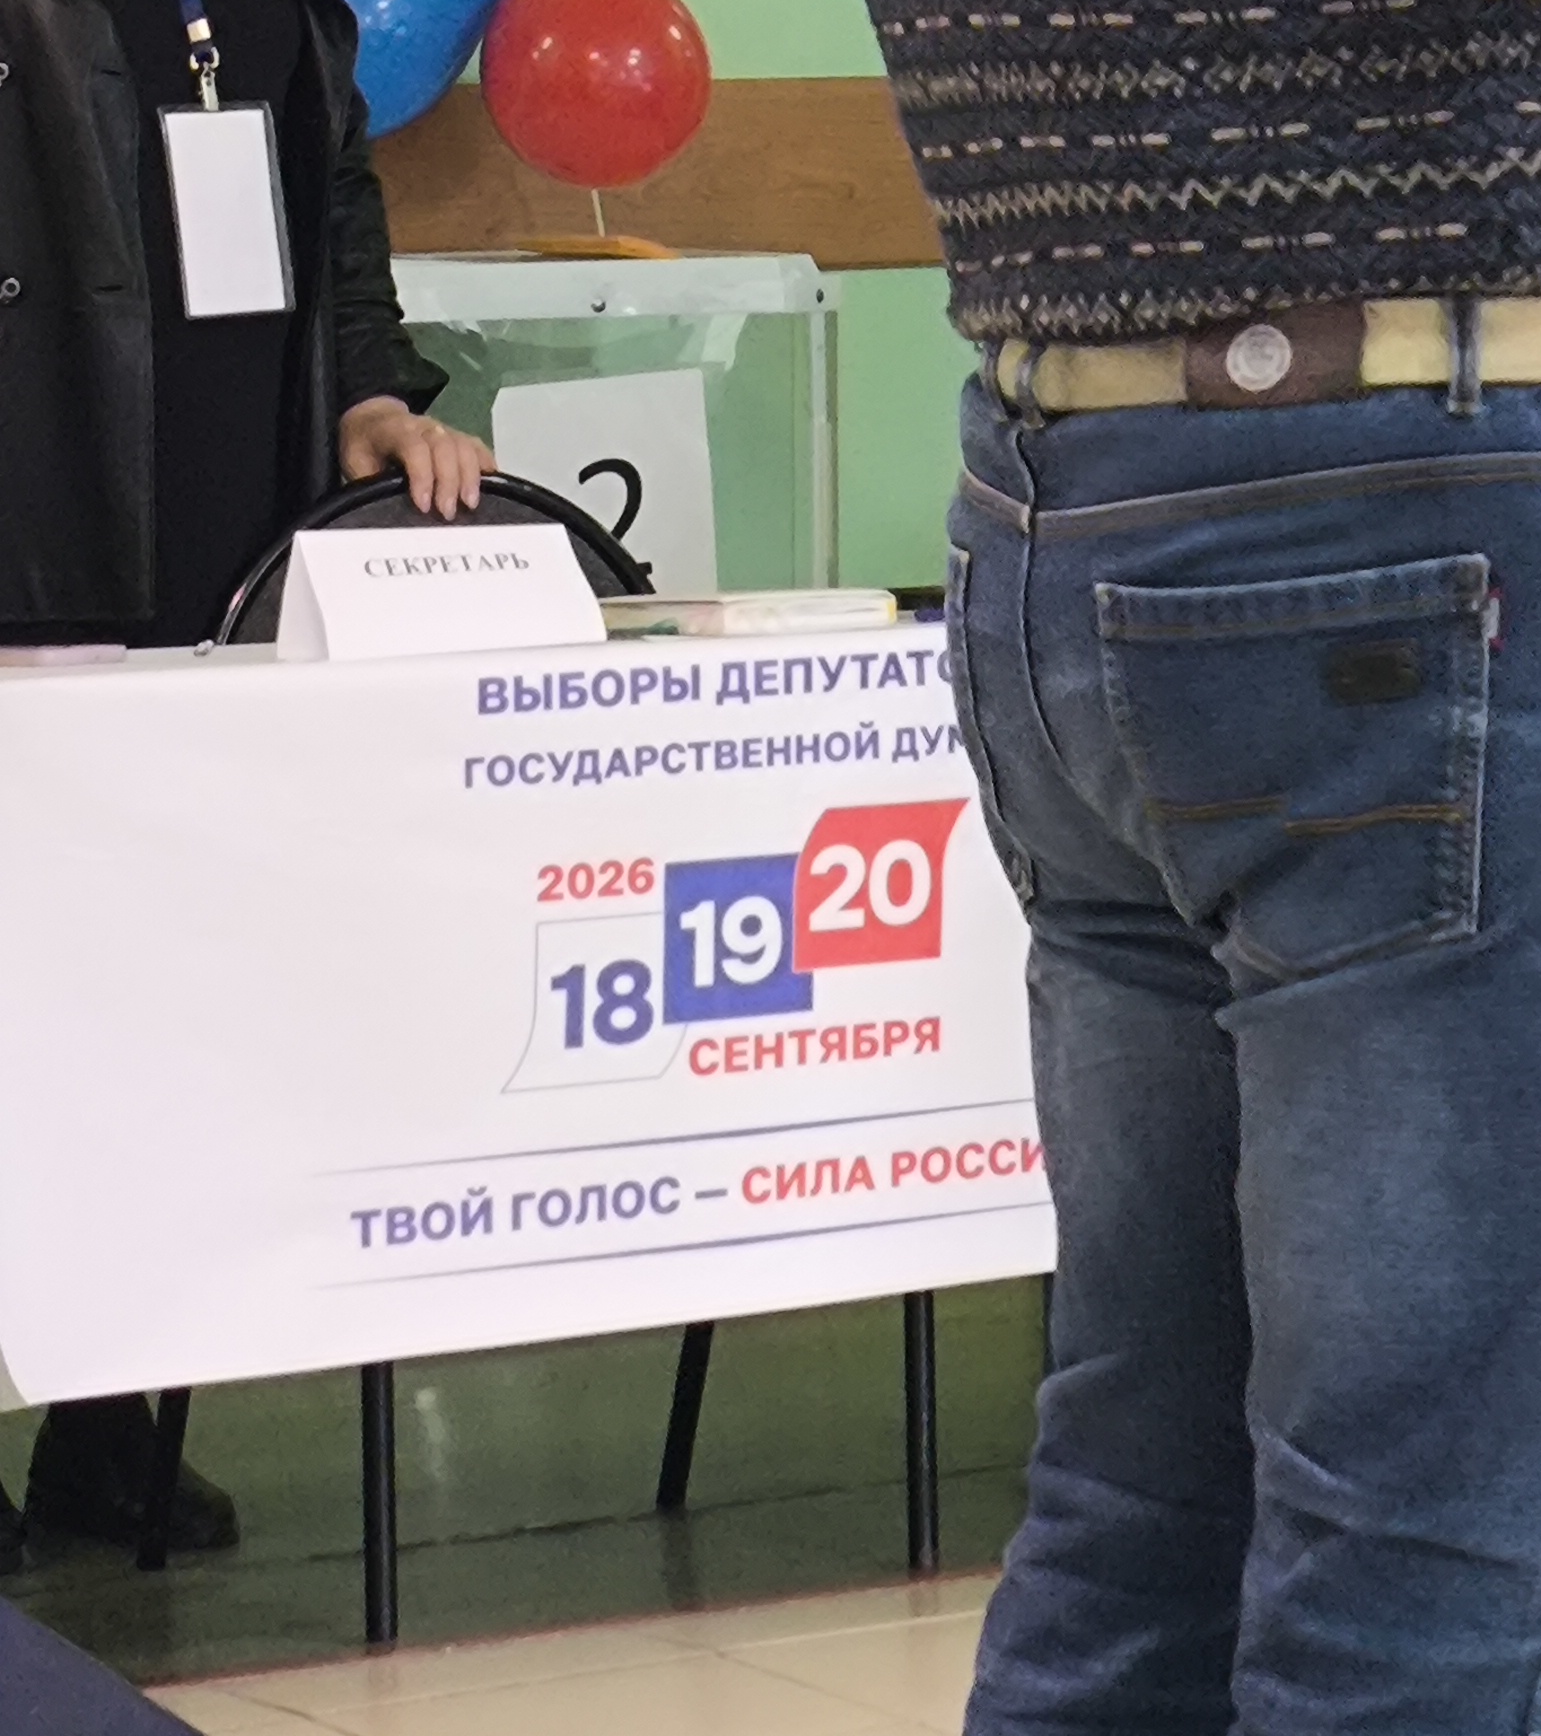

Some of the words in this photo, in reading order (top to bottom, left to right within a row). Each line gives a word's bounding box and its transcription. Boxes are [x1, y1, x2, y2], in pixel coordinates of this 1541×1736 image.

[363, 552, 531, 578] СЕКРЕТАРЬ
[477, 664, 701, 716] ВЫБОРЫ
[463, 721, 881, 789] ГОСУДАРСТВЕННОЙ
[536, 856, 656, 903] 2026
[808, 837, 931, 933] 20
[679, 894, 783, 988] 19
[550, 958, 655, 1050] 18
[687, 1015, 942, 1078] СЕНТЯБРЯ
[350, 1187, 494, 1249] ТВОЙ
[510, 1176, 681, 1232] ГОЛОС
[741, 1155, 876, 1205] СИЛА
